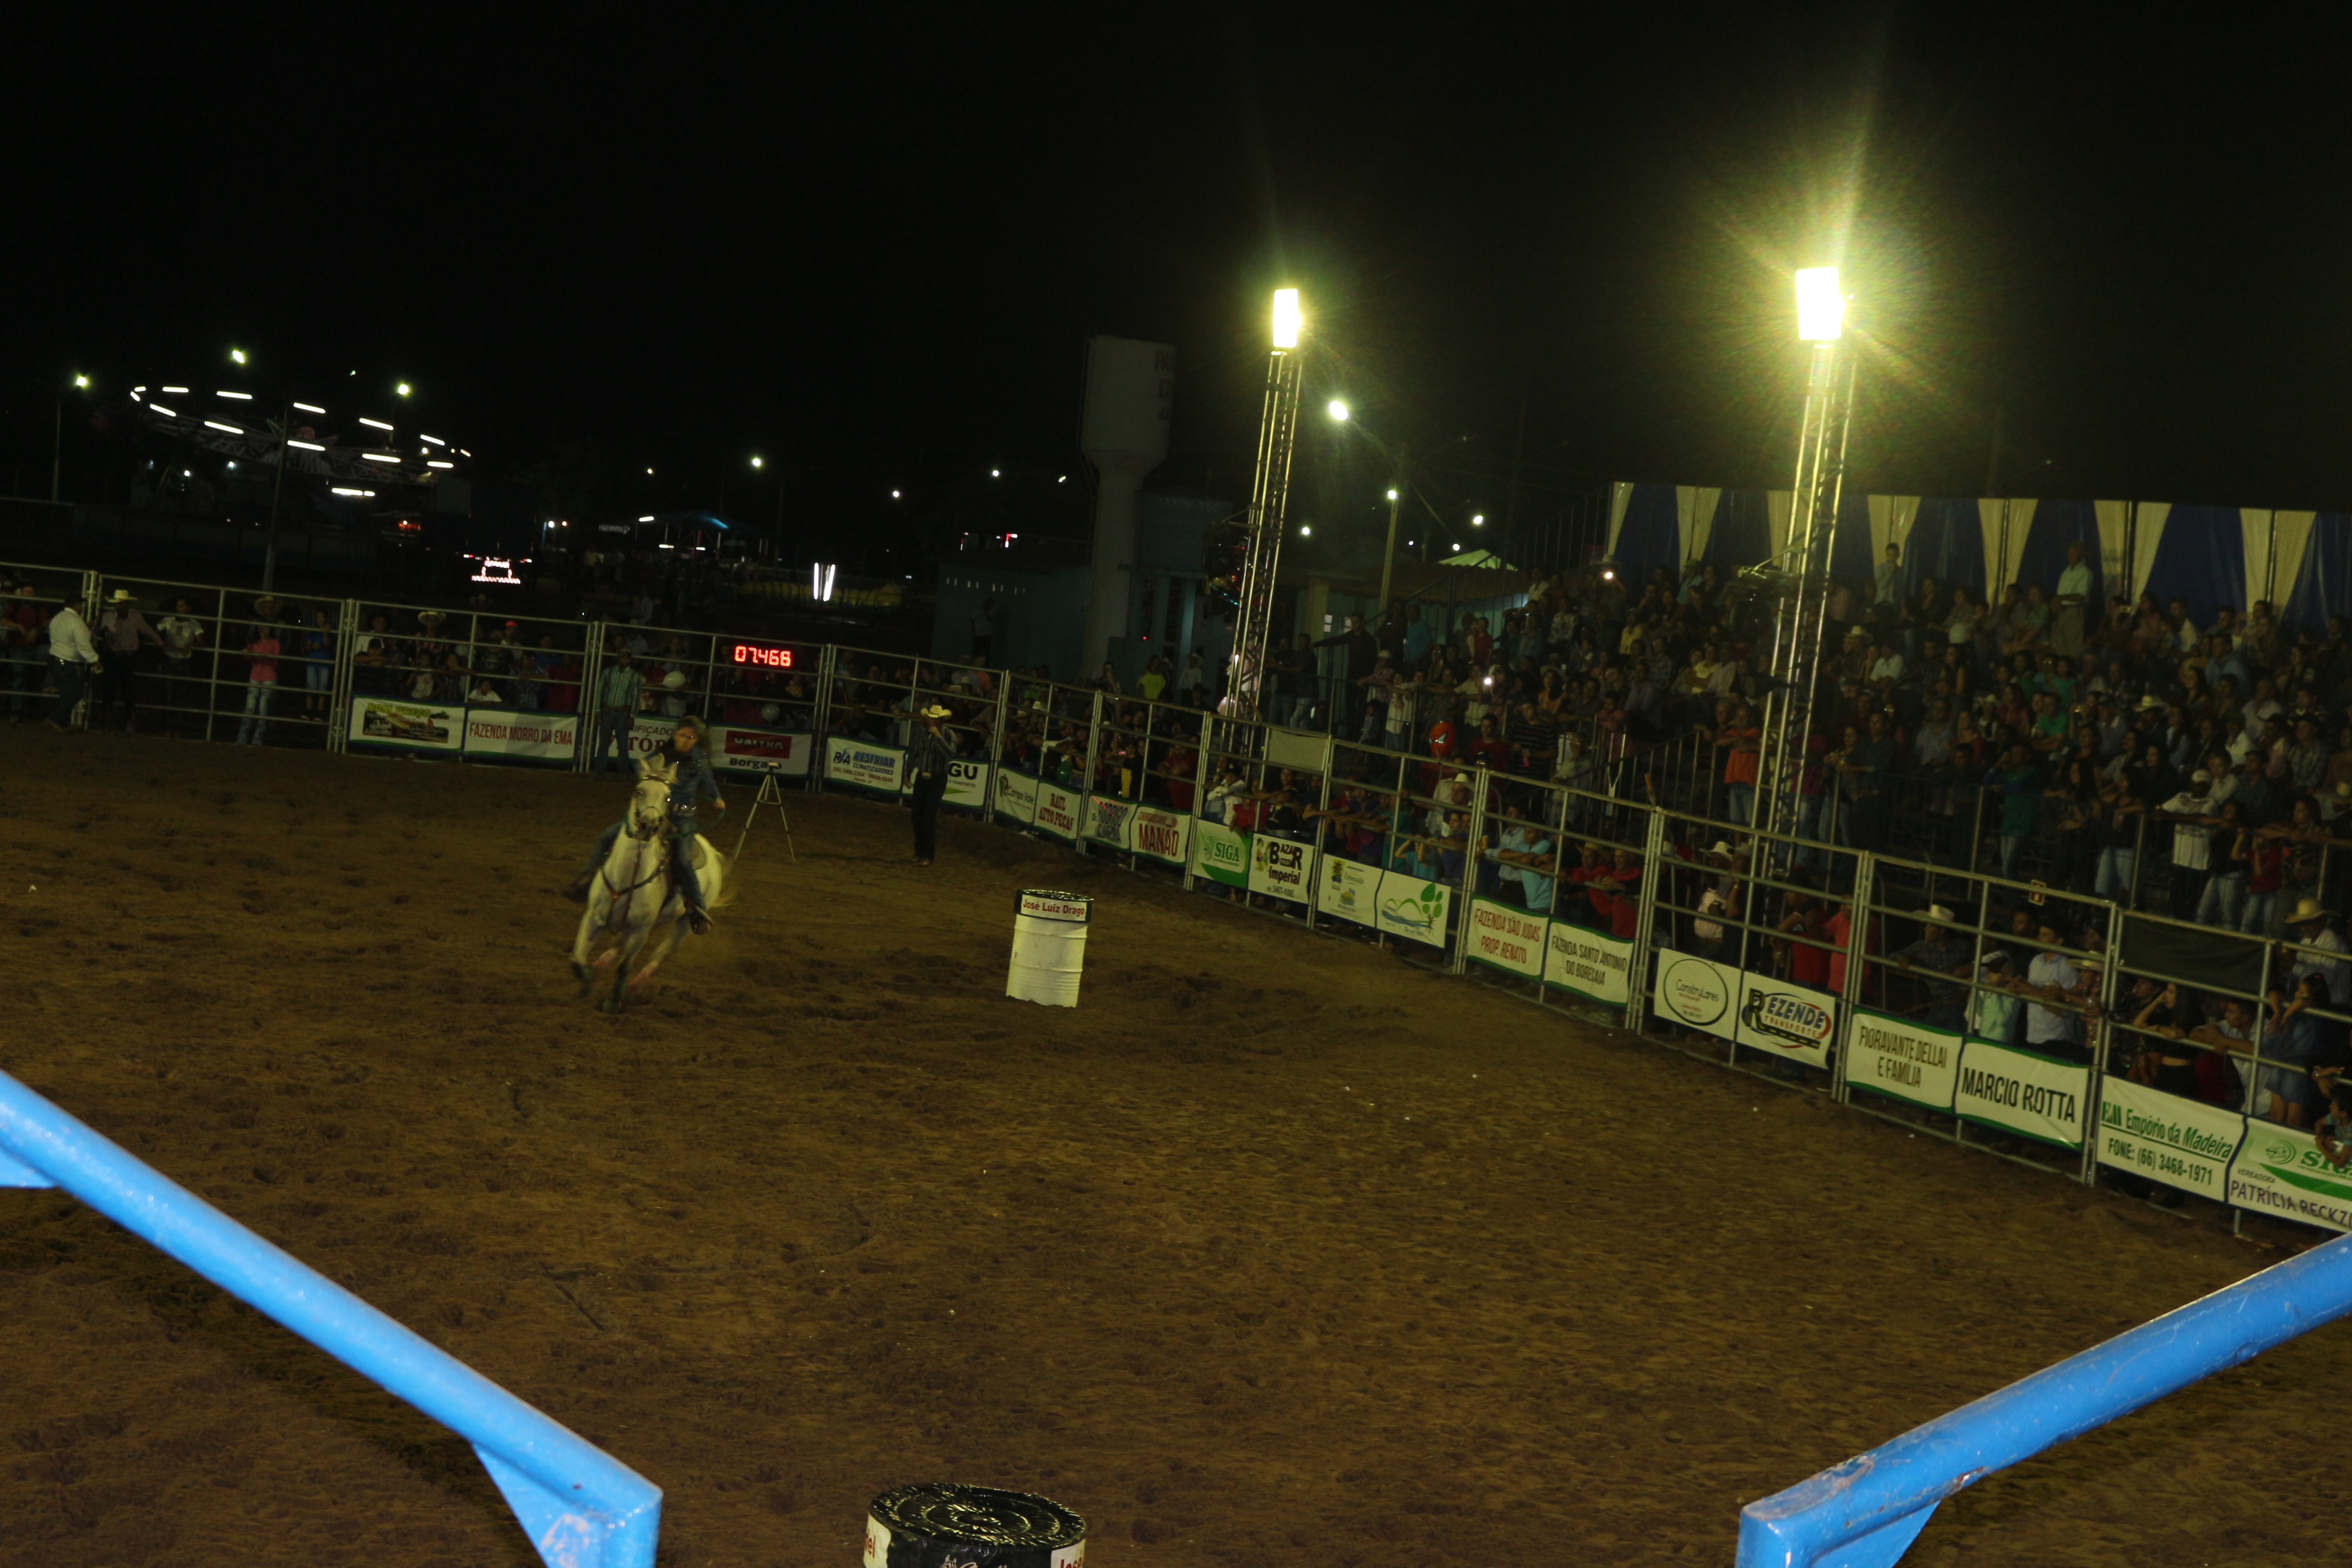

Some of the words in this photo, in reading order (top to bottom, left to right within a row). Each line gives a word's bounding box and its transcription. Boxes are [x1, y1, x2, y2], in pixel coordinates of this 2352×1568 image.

[469, 723, 507, 740] FAZENDA
[509, 726, 539, 743] MORRO
[541, 728, 552, 743] DA
[554, 730, 573, 745] EMA
[734, 737, 784, 750] VALTRA
[730, 758, 782, 769] Borgao
[853, 750, 896, 768] RESFRIAR
[853, 762, 894, 775] CLIMATIZADORES
[1038, 806, 1054, 824] AUTO
[1054, 811, 1074, 832] PEÇAS
[1214, 841, 1240, 862] SIGA
[1269, 841, 1303, 871] BAZAR
[1269, 865, 1301, 885] Imperial
[1023, 899, 1039, 910] José
[1042, 902, 1060, 913] Luiz
[1062, 905, 1085, 917] Drago
[1475, 908, 1506, 932] FAZENDA
[1507, 916, 1521, 936] SÃO
[1521, 922, 1541, 942] JUDAS
[1481, 935, 1500, 956] PROP.
[1500, 942, 1527, 964] RENATO
[1551, 935, 1578, 957] FAZENDA
[1579, 944, 1600, 963] SANTO
[1600, 951, 1627, 972] ANTONIO
[1566, 960, 1575, 975] DO
[1746, 988, 1826, 1030] REZENDE
[1764, 1015, 1823, 1038] TRANSPORTES
[1858, 1025, 1915, 1059] FIORAVANTE
[1915, 1040, 1947, 1069] DELLAI
[1877, 1056, 1885, 1077] E
[1886, 1058, 1921, 1088] FAMÍLIA
[1961, 1066, 2020, 1108] MARCIO
[2023, 1083, 2076, 1124] ROTTA
[2126, 1108, 2166, 1139] Empório
[2167, 1122, 2181, 1144] da
[2182, 1126, 2234, 1159] Madeira
[2108, 1137, 2135, 1161] FONE:
[2137, 1147, 2156, 1171] (66)
[2158, 1153, 2213, 1186] 3468-1971
[2237, 1168, 2275, 1184] VEREADORA
[2230, 1180, 2298, 1212] PATRÍCIA
